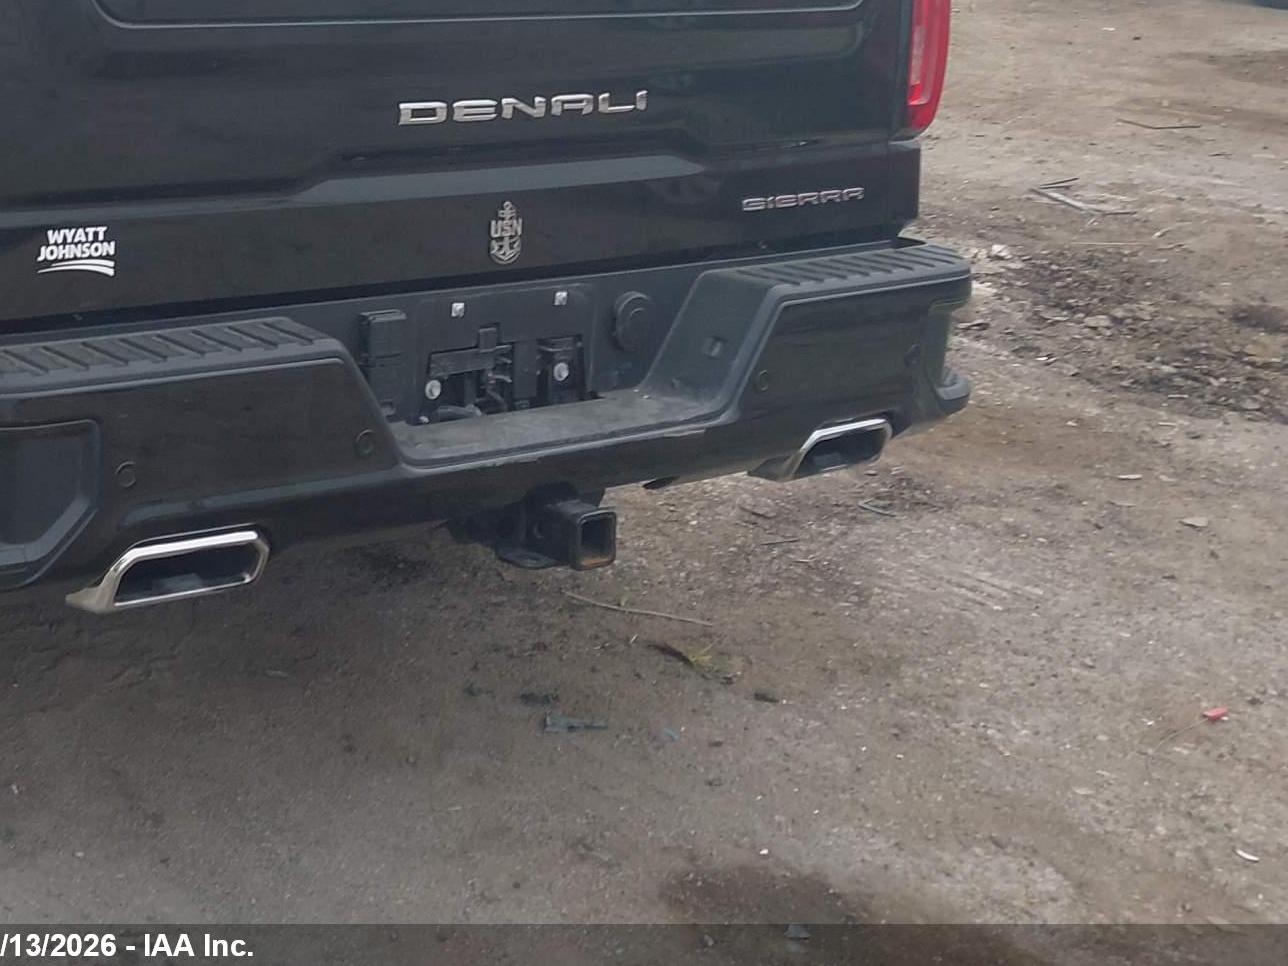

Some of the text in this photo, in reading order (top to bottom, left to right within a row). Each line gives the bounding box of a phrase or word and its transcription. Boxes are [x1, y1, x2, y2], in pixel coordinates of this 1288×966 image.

[398, 90, 648, 126] DENALI
[742, 187, 864, 211] SIERRA
[47, 226, 108, 245] WYATT
[490, 218, 522, 238] USN
[36, 241, 116, 262] JOHNSON
